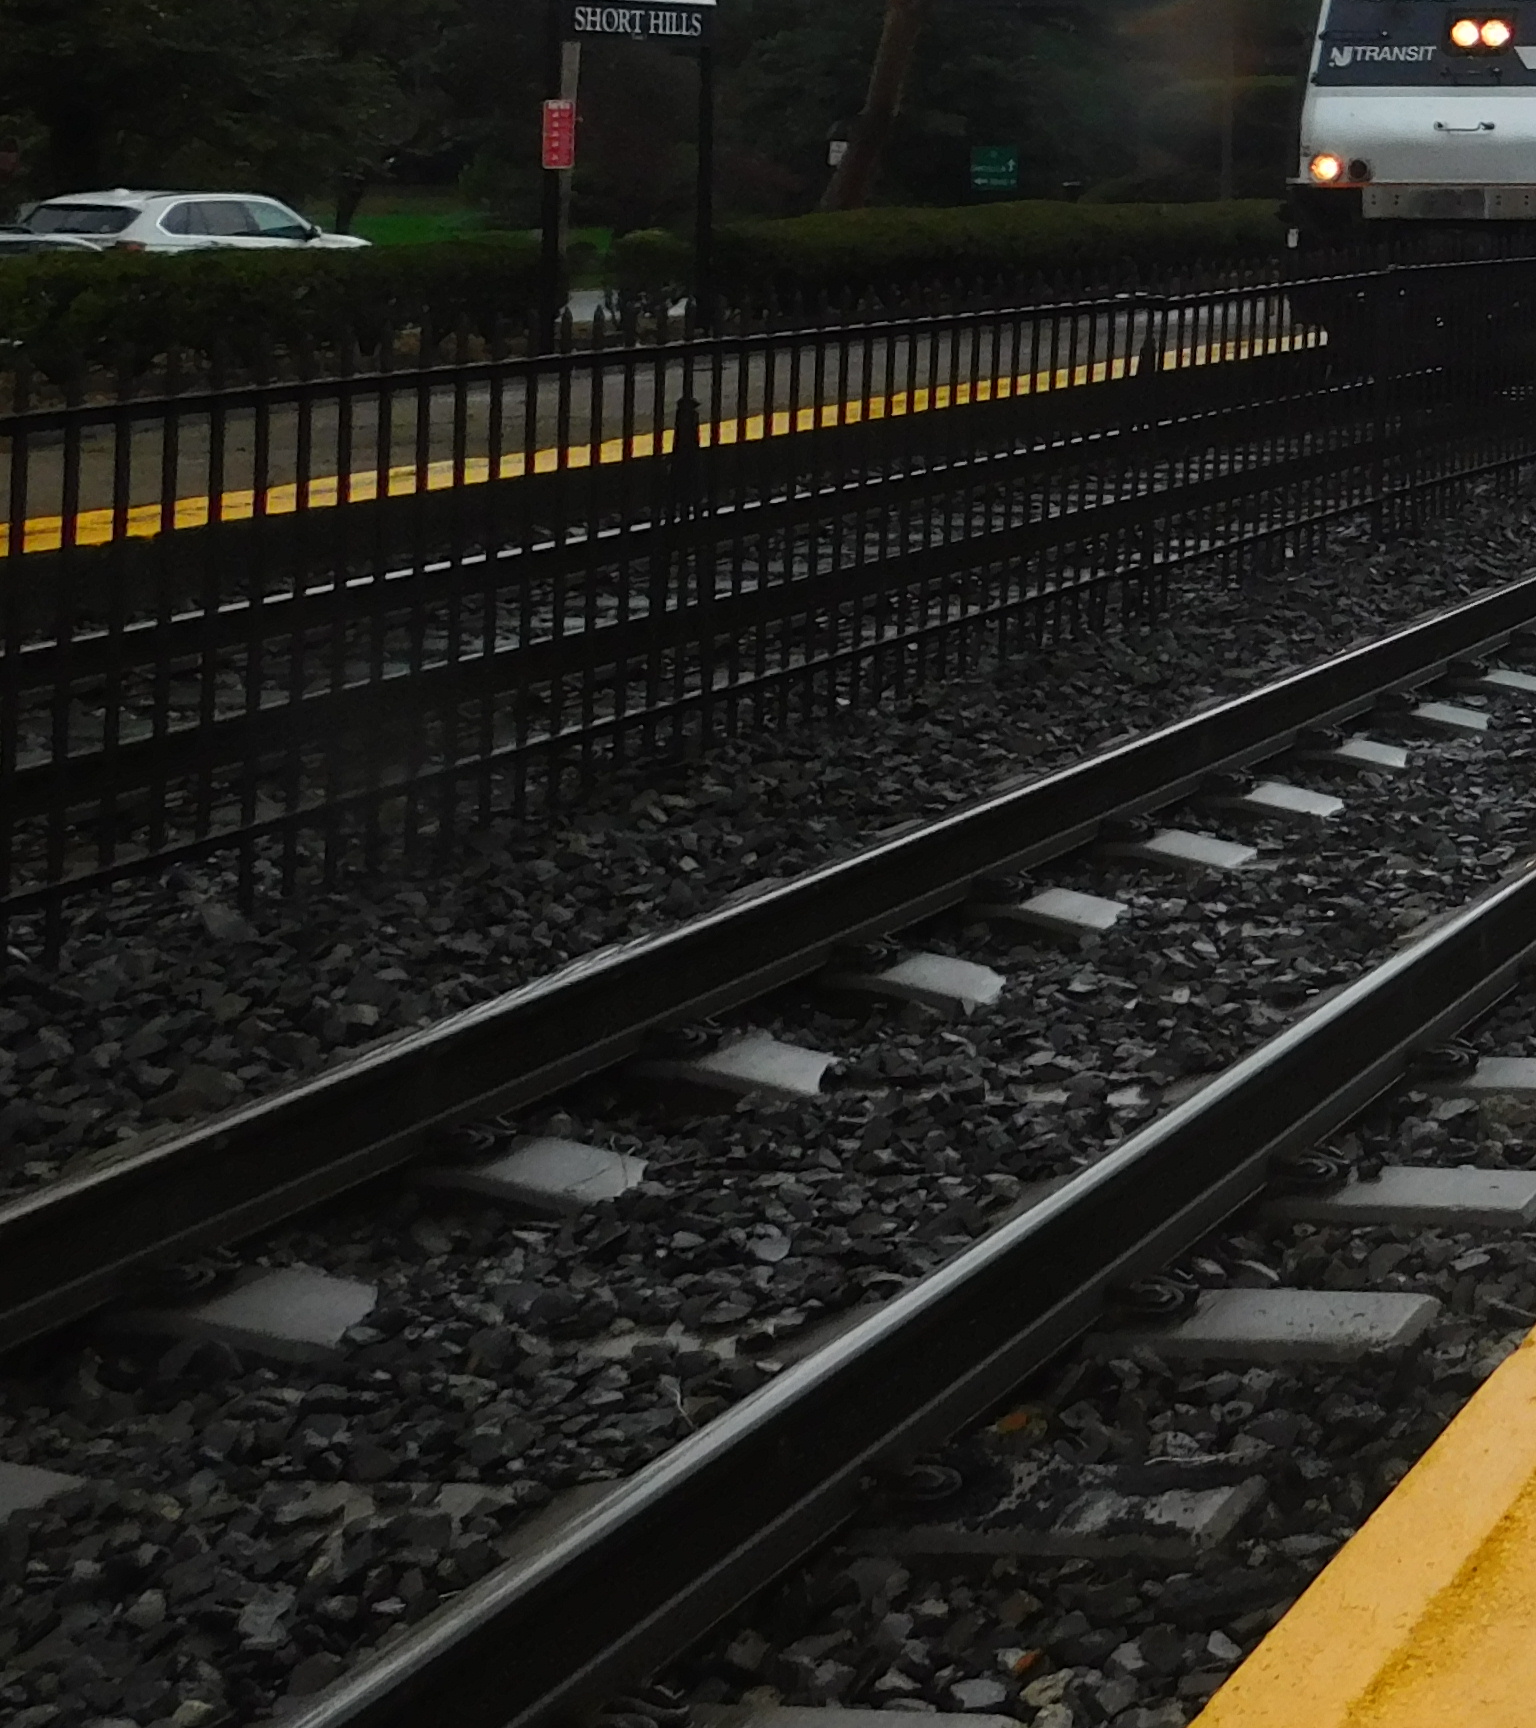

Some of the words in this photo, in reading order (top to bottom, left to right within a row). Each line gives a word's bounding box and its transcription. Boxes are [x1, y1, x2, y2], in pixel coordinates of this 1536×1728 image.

[574, 6, 645, 33] SHORT
[649, 11, 702, 37] HILLS
[1354, 45, 1437, 61] TRANSIT
